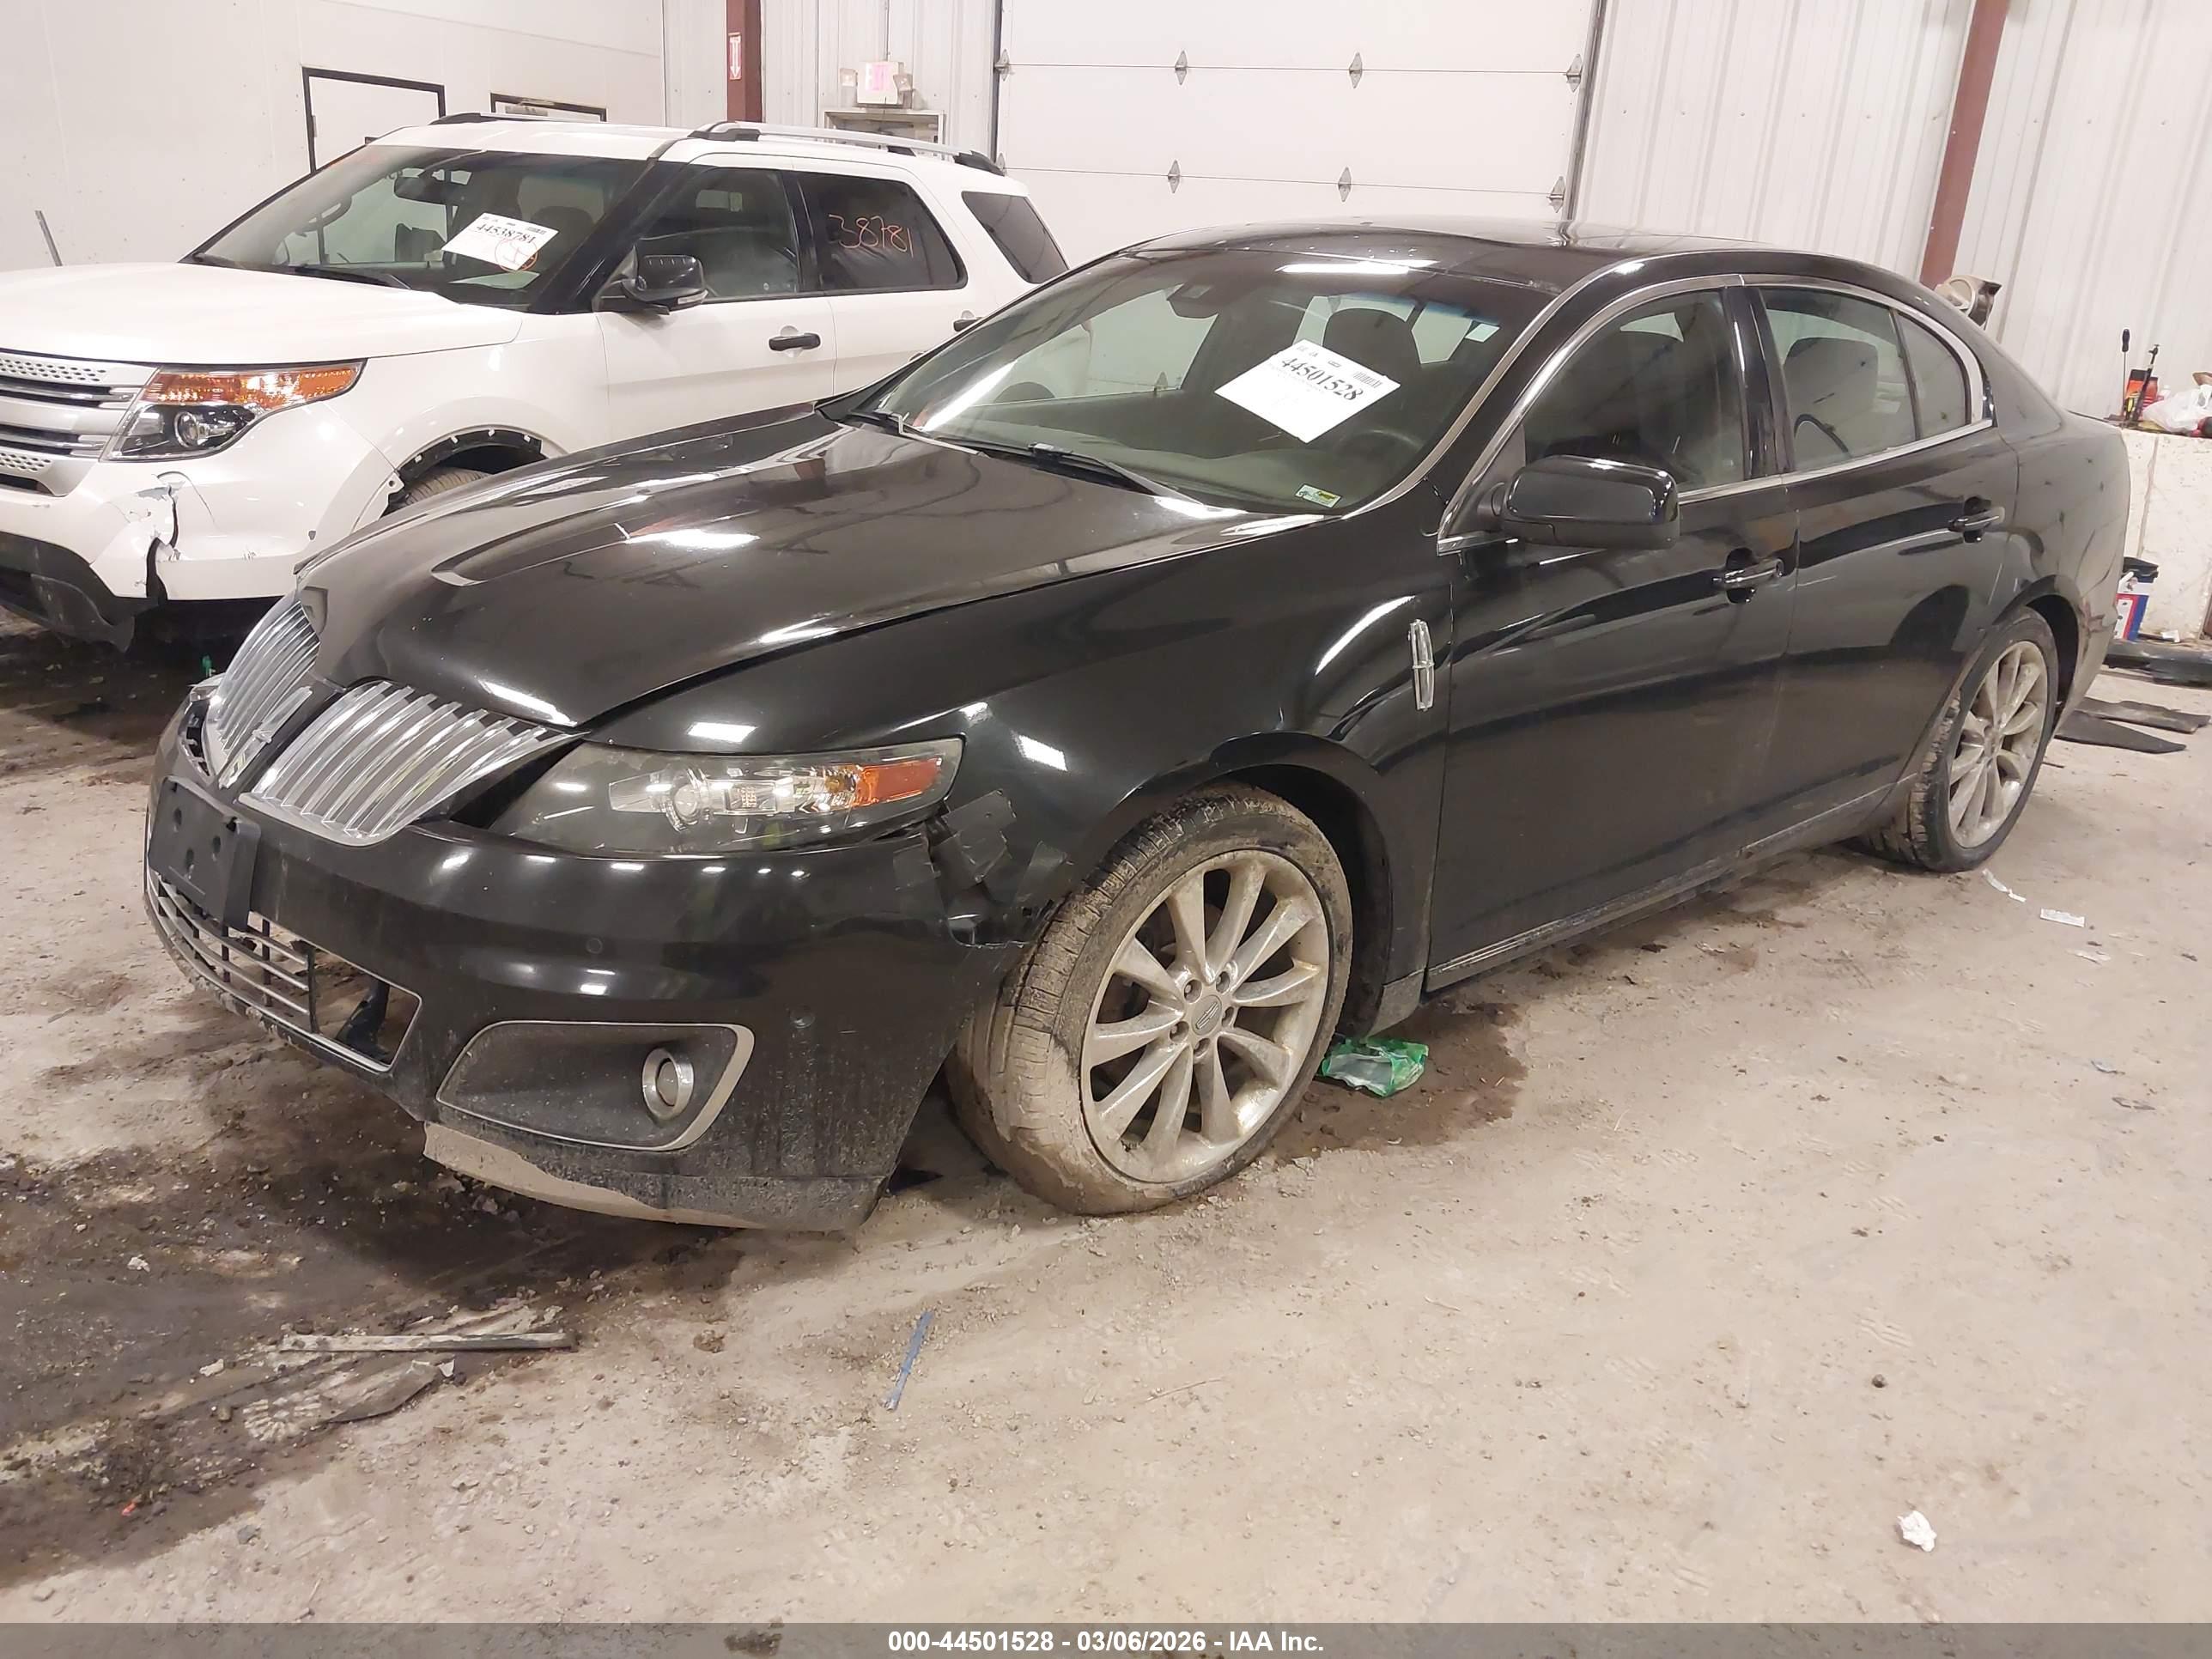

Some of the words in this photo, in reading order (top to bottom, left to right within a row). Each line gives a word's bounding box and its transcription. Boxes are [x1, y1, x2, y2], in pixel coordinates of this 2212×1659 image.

[477, 223, 537, 244] 44538781
[828, 214, 914, 258] 38781
[1281, 357, 1364, 401] 44501528
